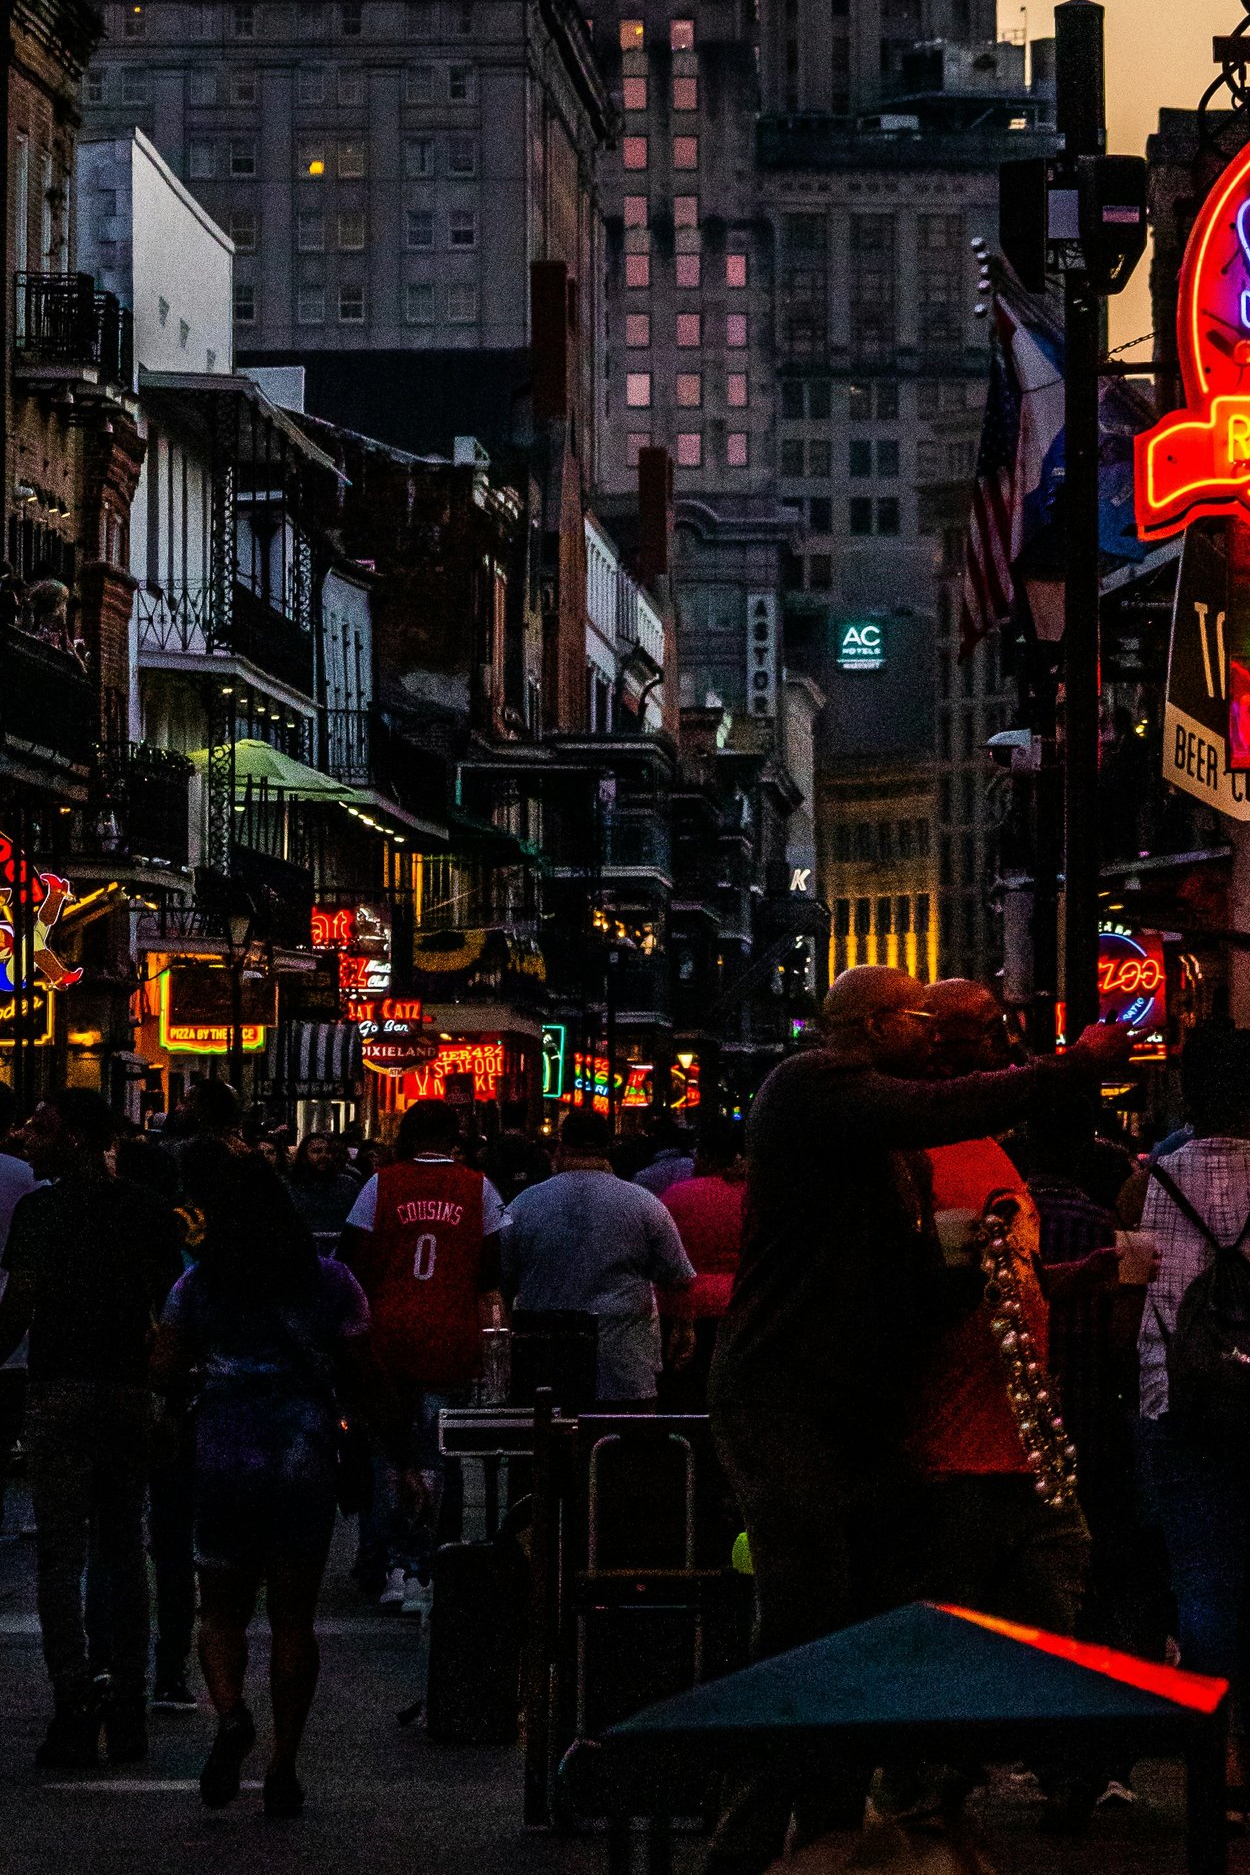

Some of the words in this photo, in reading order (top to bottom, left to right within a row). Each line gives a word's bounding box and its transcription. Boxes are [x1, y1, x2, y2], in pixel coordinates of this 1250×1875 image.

[842, 626, 881, 647] AC
[1174, 724, 1219, 792] BEER
[170, 1028, 195, 1039] PIZZA
[197, 1028, 209, 1039] BY
[210, 1028, 227, 1039] THE
[230, 1028, 254, 1039] SCE
[361, 1046, 436, 1057] DIXIELAND
[439, 1049, 471, 1061] IER
[397, 1200, 464, 1225] COUSINS
[413, 1233, 437, 1280] 0
